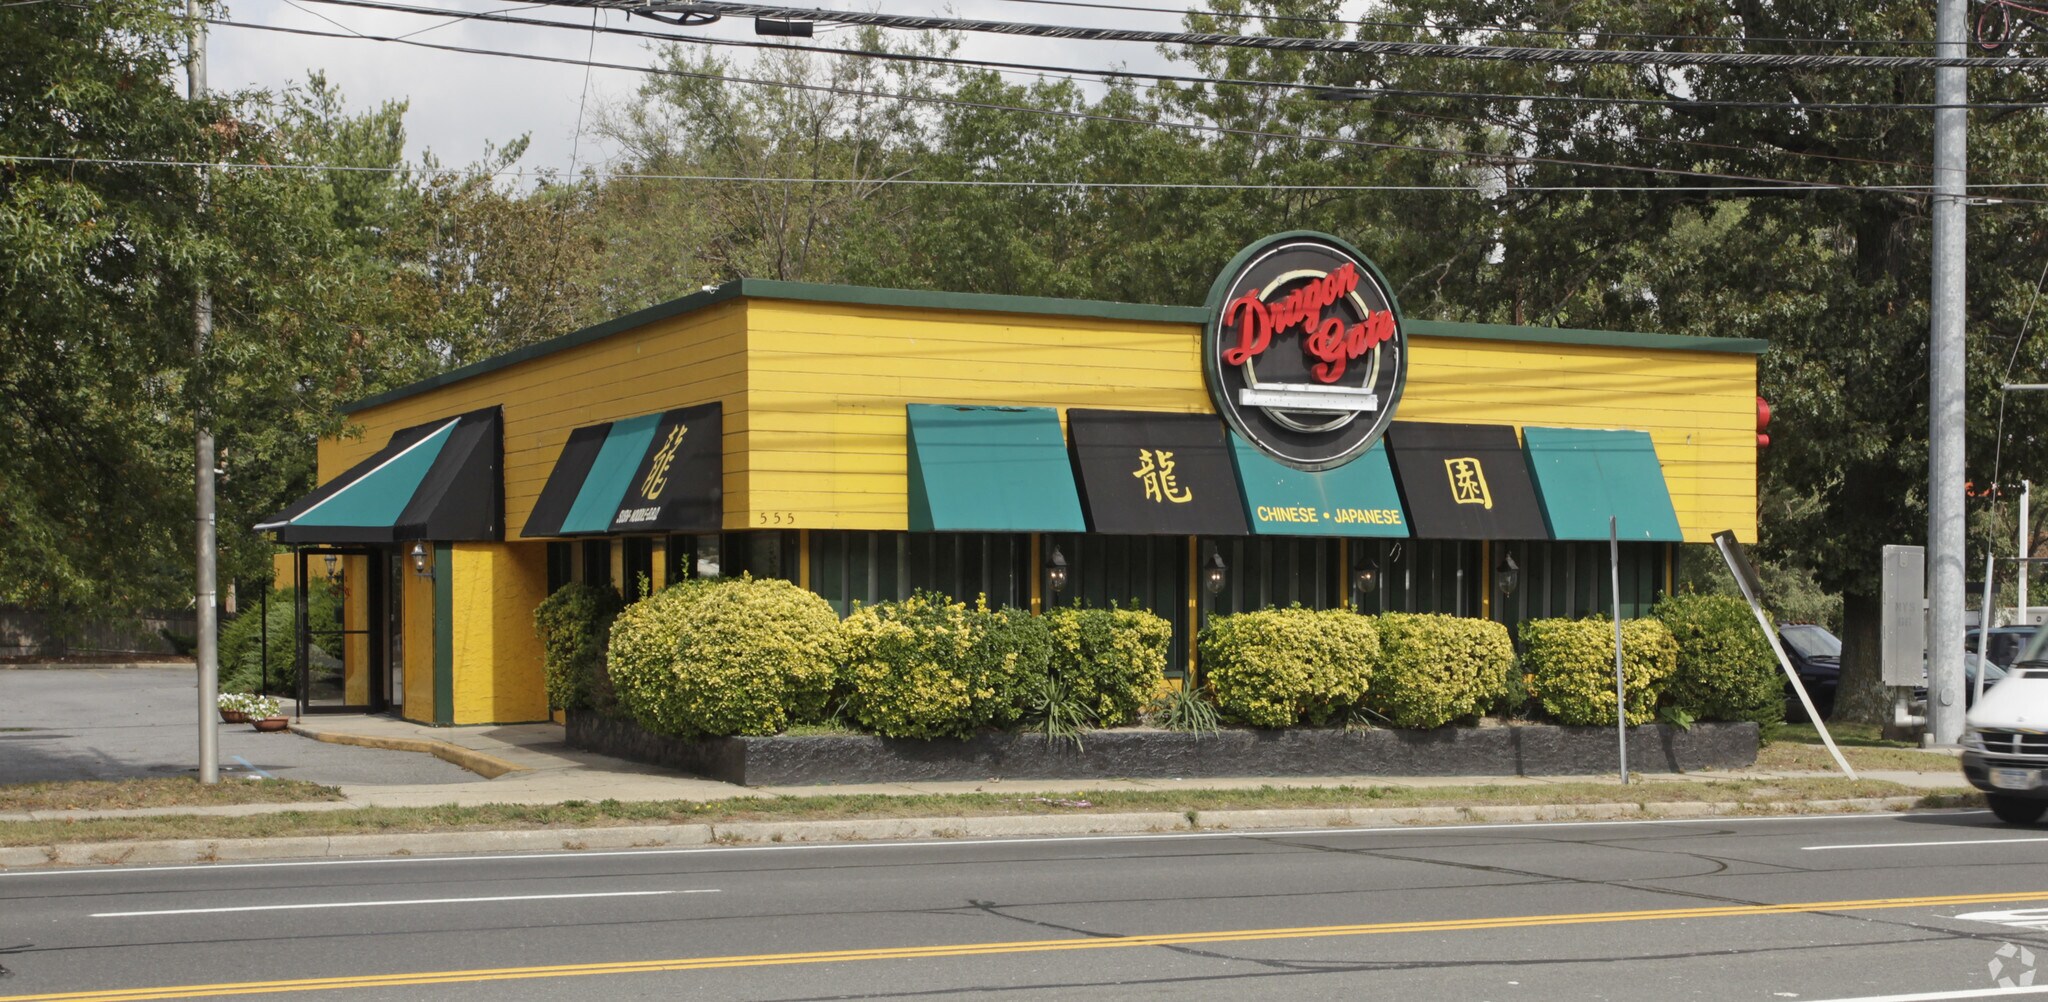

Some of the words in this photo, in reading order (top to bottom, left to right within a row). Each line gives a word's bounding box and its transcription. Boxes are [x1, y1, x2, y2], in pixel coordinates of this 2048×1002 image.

[1222, 262, 1361, 366] Dragon
[1305, 309, 1396, 383] Gate
[1132, 448, 1193, 503] 龍
[1257, 506, 1319, 523] CHINESE
[1334, 508, 1402, 525] JAPANESE
